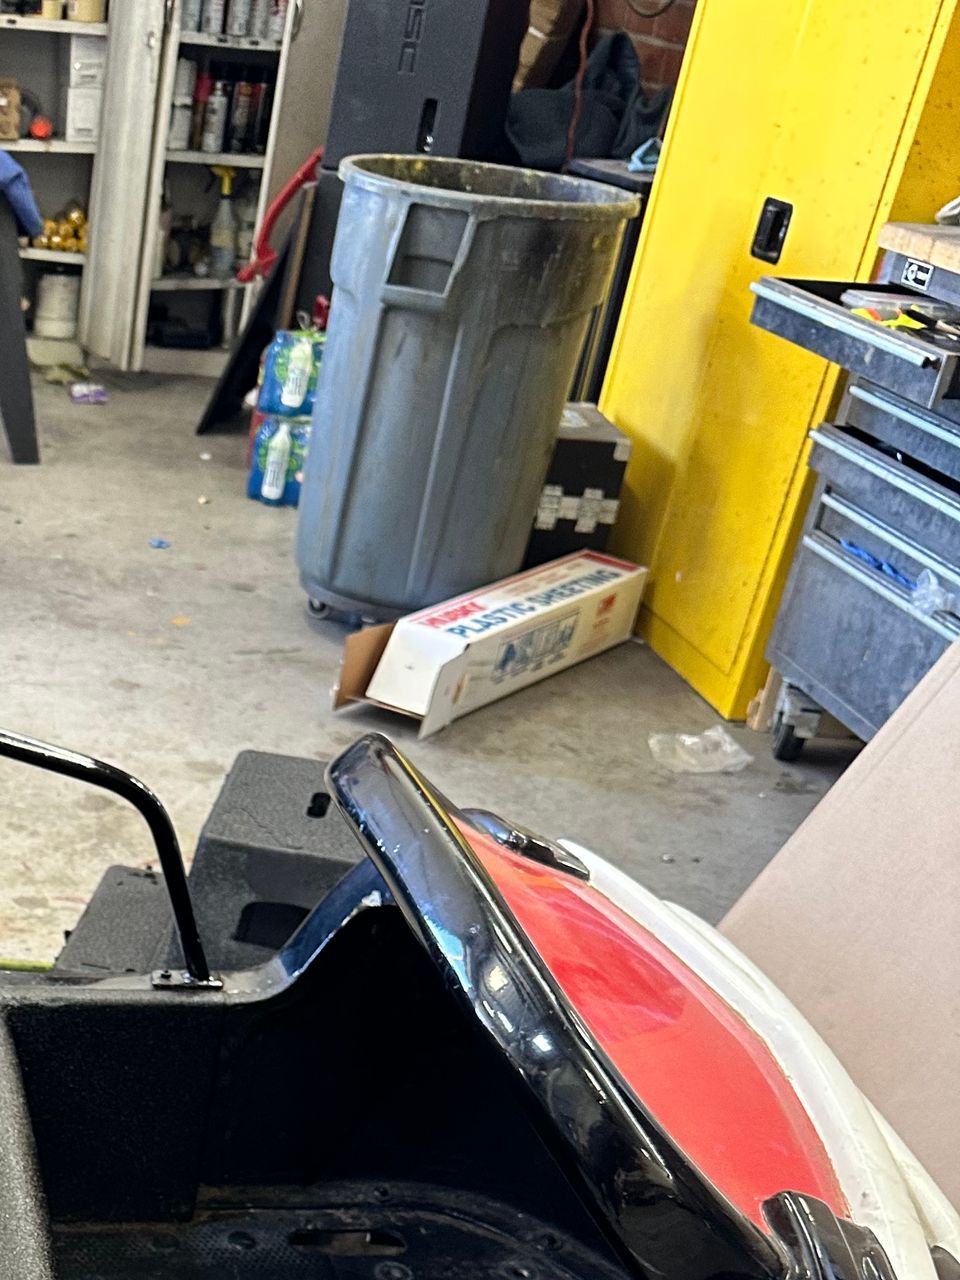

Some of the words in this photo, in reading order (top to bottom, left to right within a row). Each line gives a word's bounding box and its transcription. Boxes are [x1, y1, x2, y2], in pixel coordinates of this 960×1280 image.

[398, 0, 425, 73] SC
[446, 601, 535, 639] PLASTIC
[526, 569, 621, 607] SHEETING
